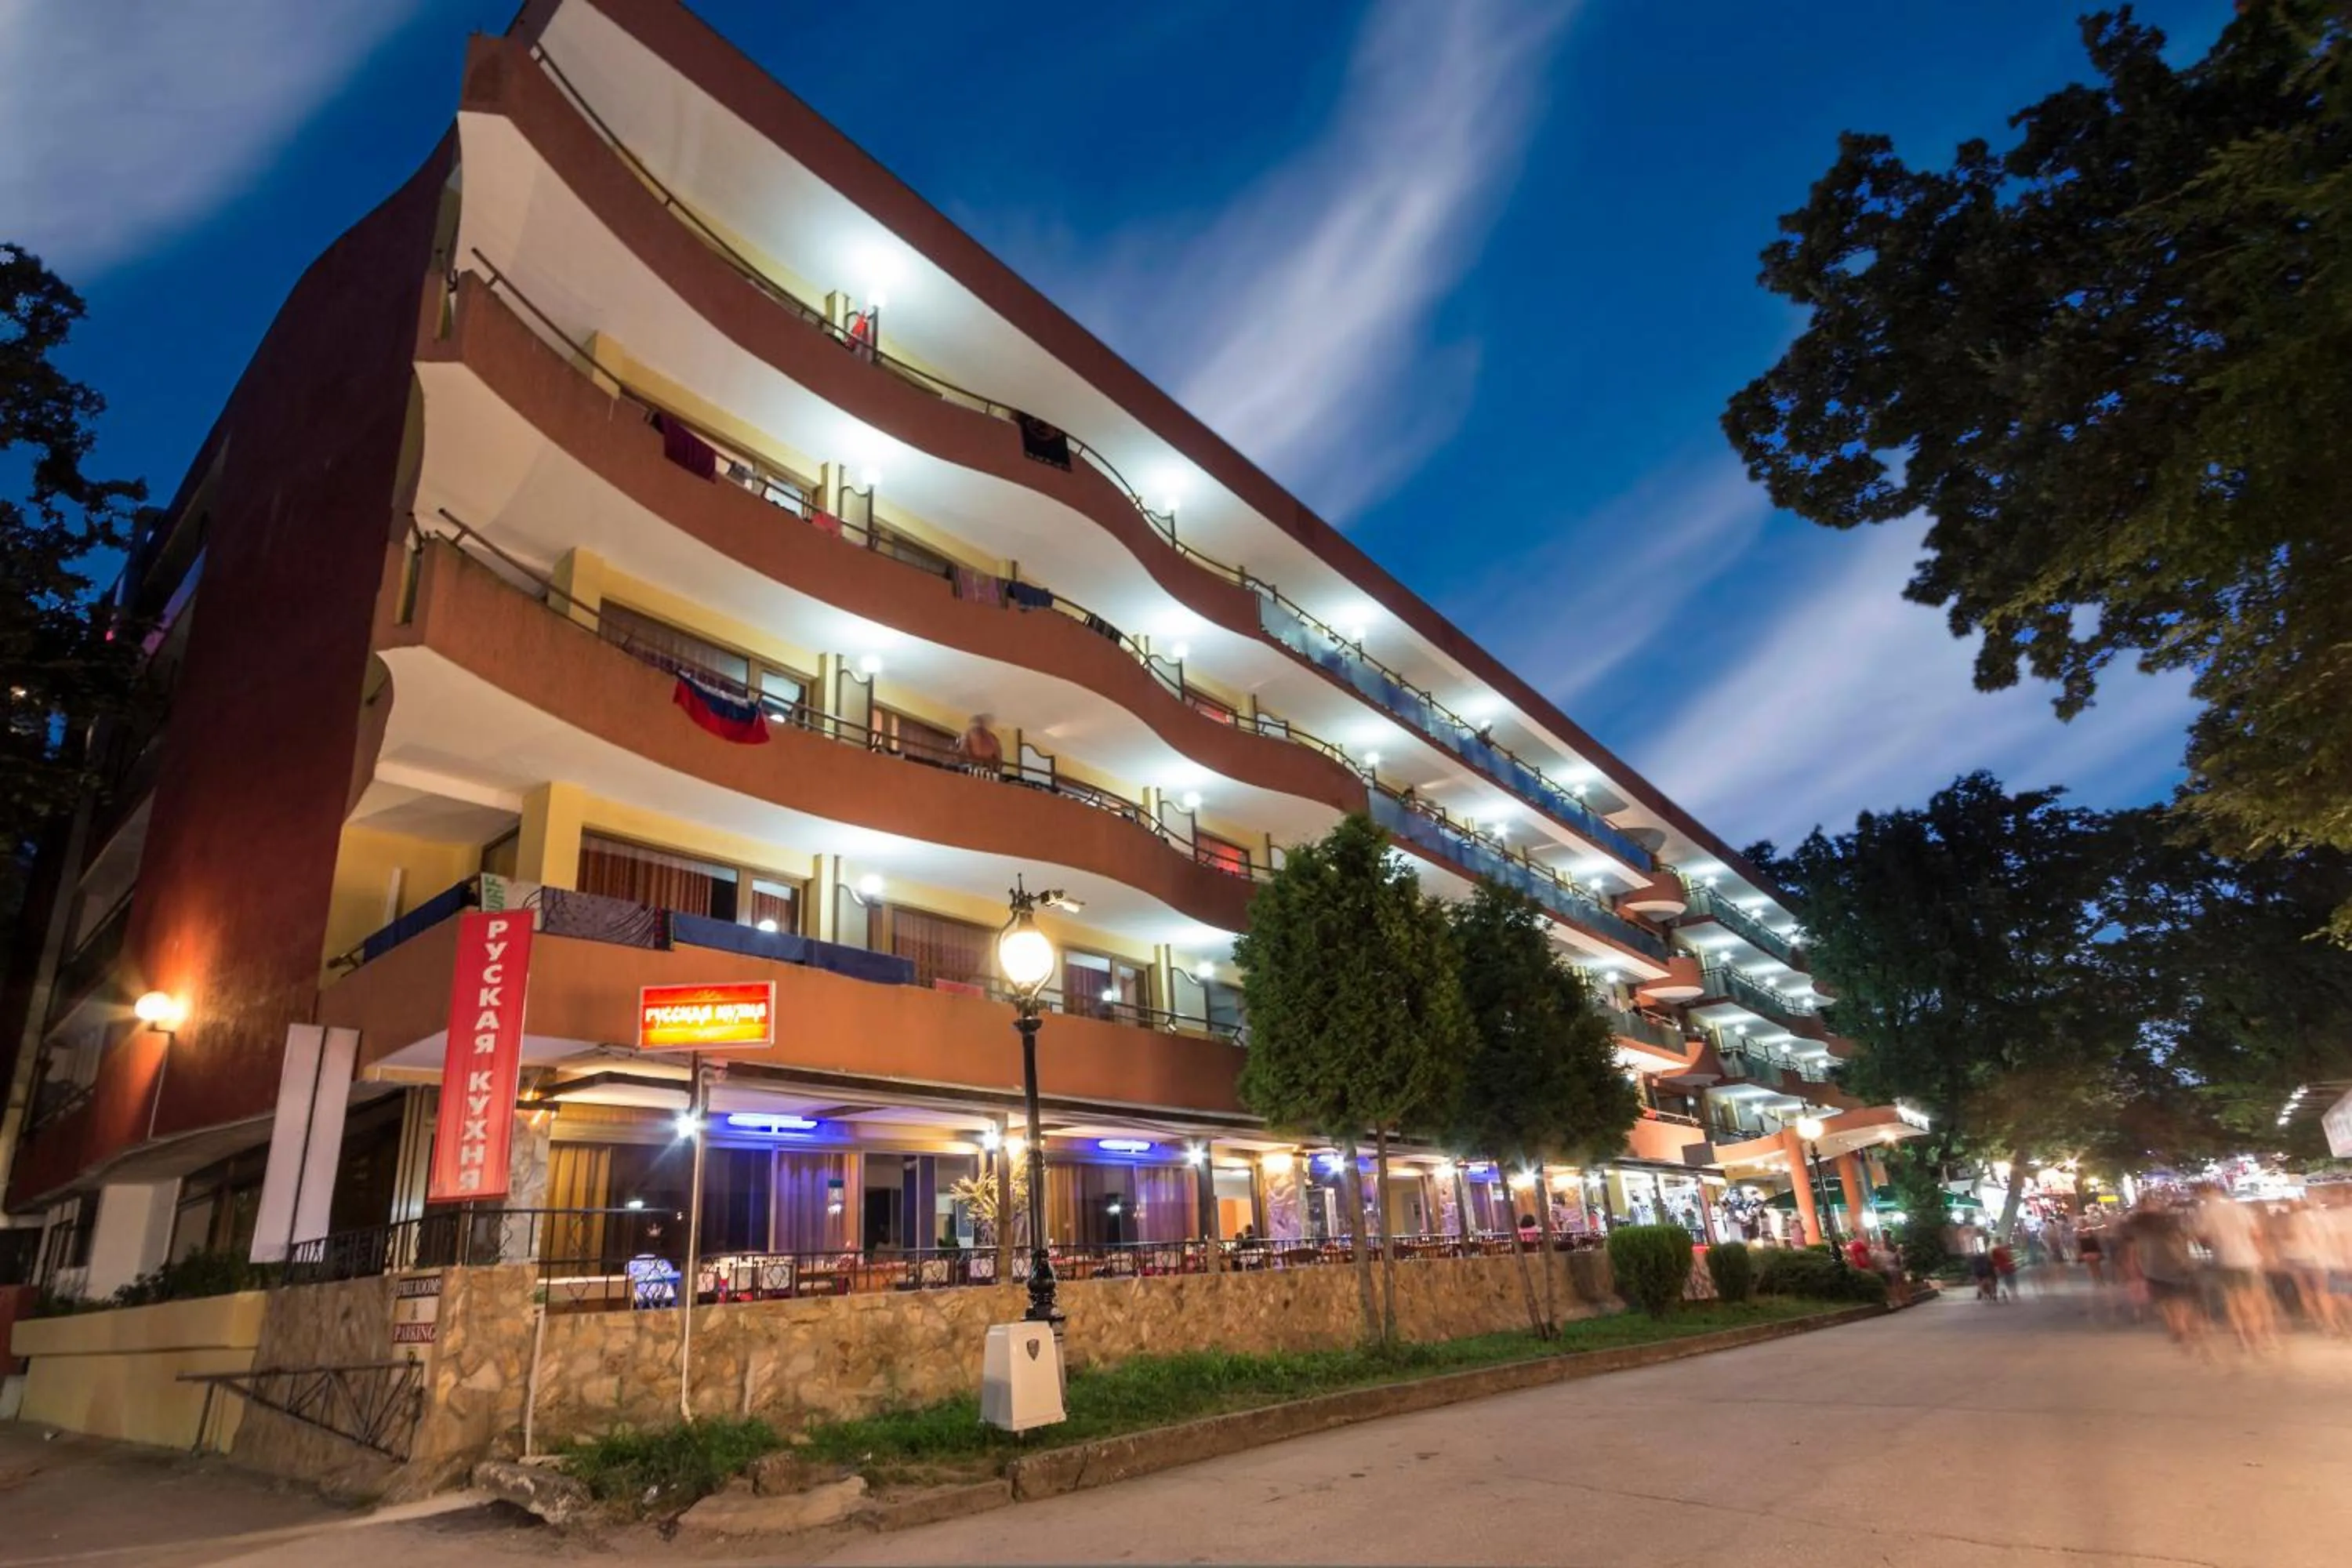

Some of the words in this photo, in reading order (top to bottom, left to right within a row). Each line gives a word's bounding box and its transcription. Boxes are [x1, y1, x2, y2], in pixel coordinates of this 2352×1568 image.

[474, 920, 509, 1054] РУСКАЯ
[459, 1071, 493, 1192] КУХНЯ
[393, 1323, 437, 1341] PARKING
